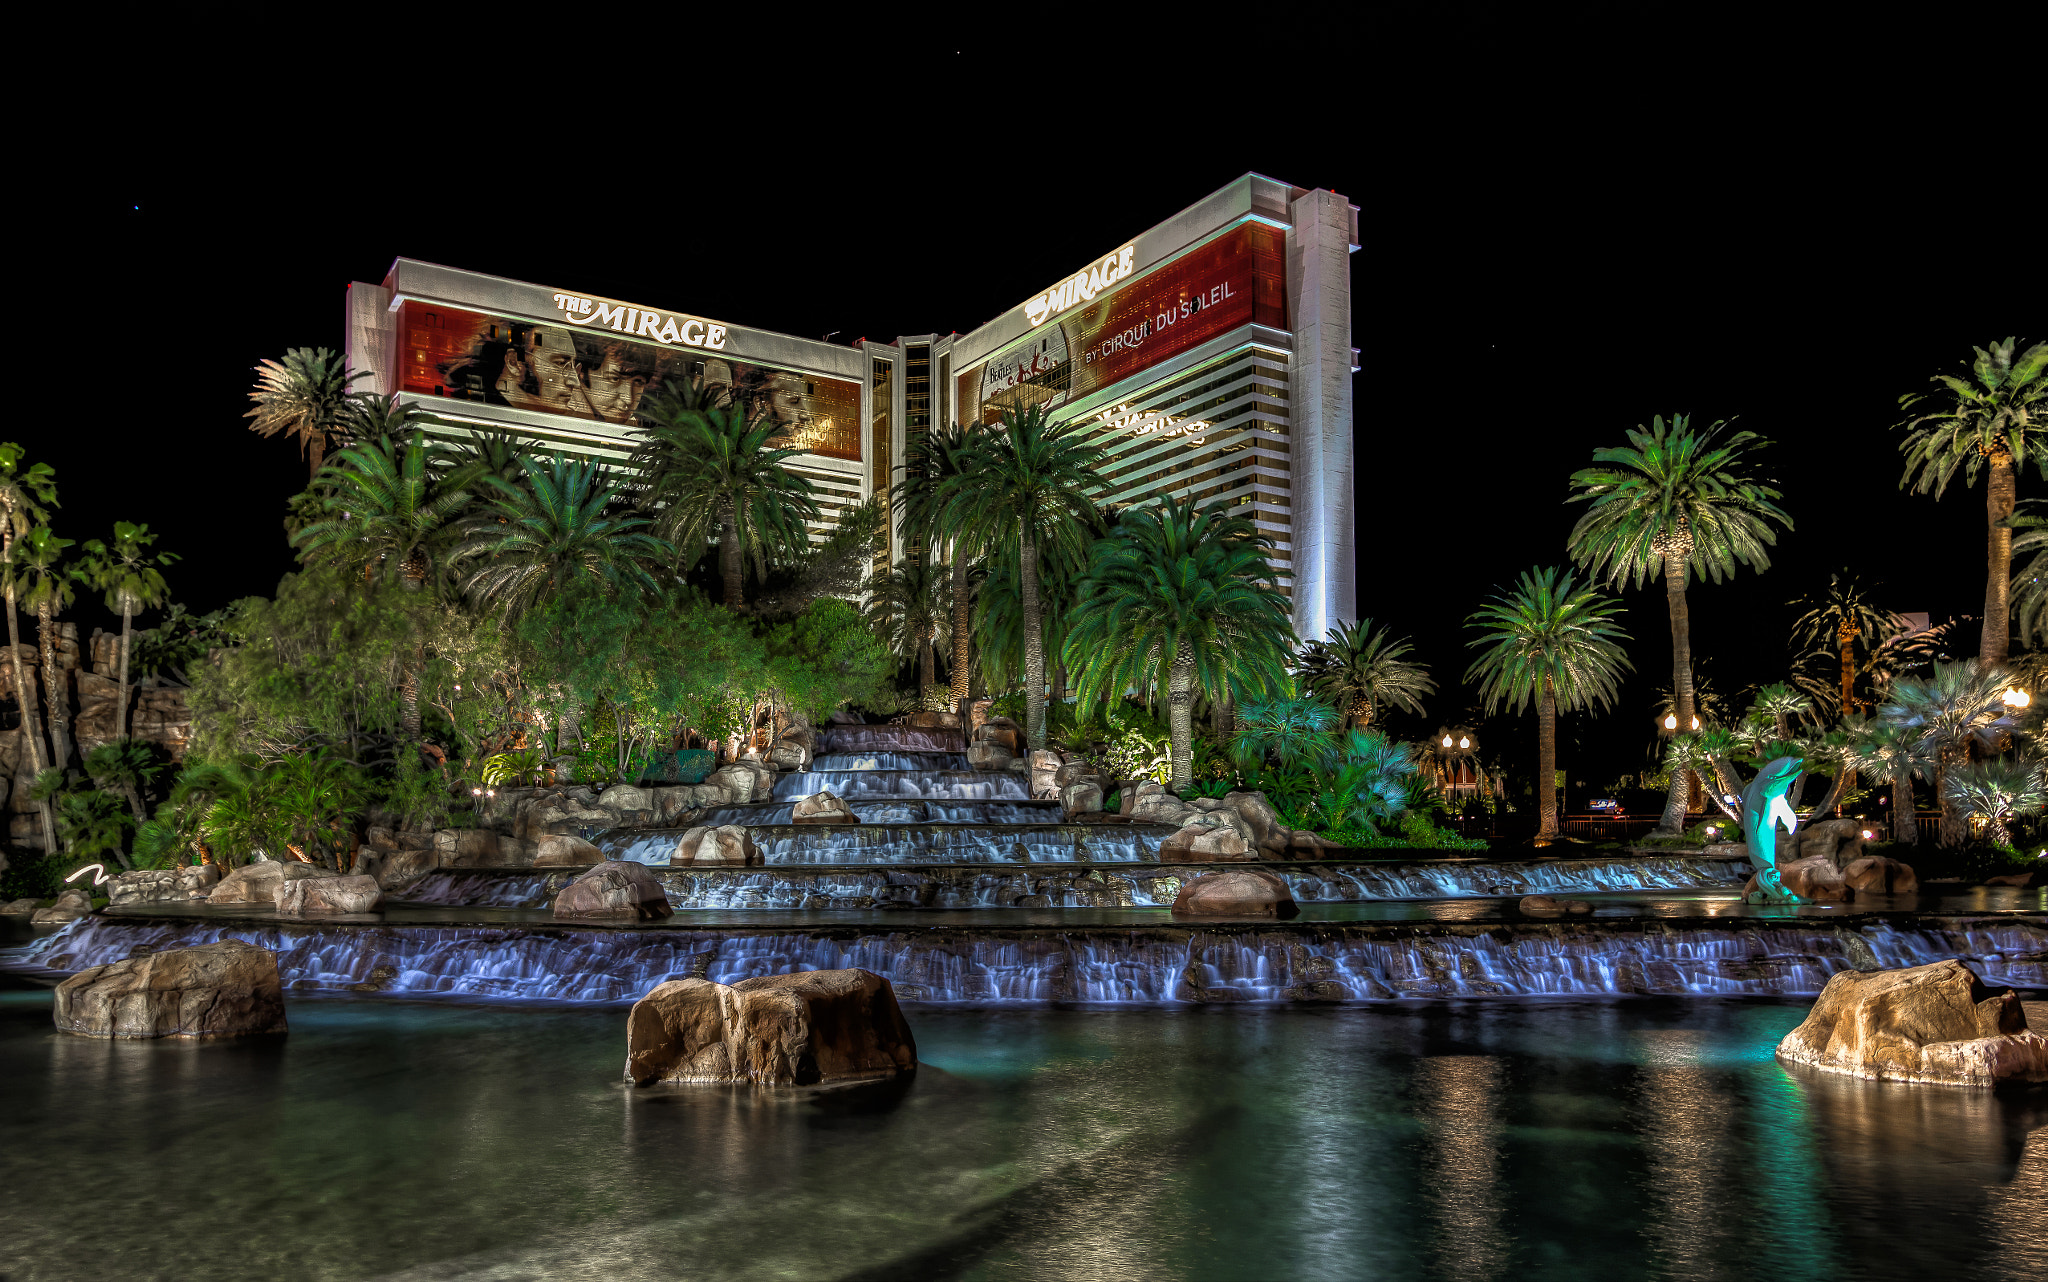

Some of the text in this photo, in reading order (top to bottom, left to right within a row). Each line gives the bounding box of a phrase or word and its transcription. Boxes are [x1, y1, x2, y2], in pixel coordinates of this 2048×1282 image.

[1031, 245, 1134, 326] MIRAGE
[554, 294, 727, 349] THE MIRAGE
[1086, 349, 1097, 364] BY
[1156, 306, 1177, 332] DU
